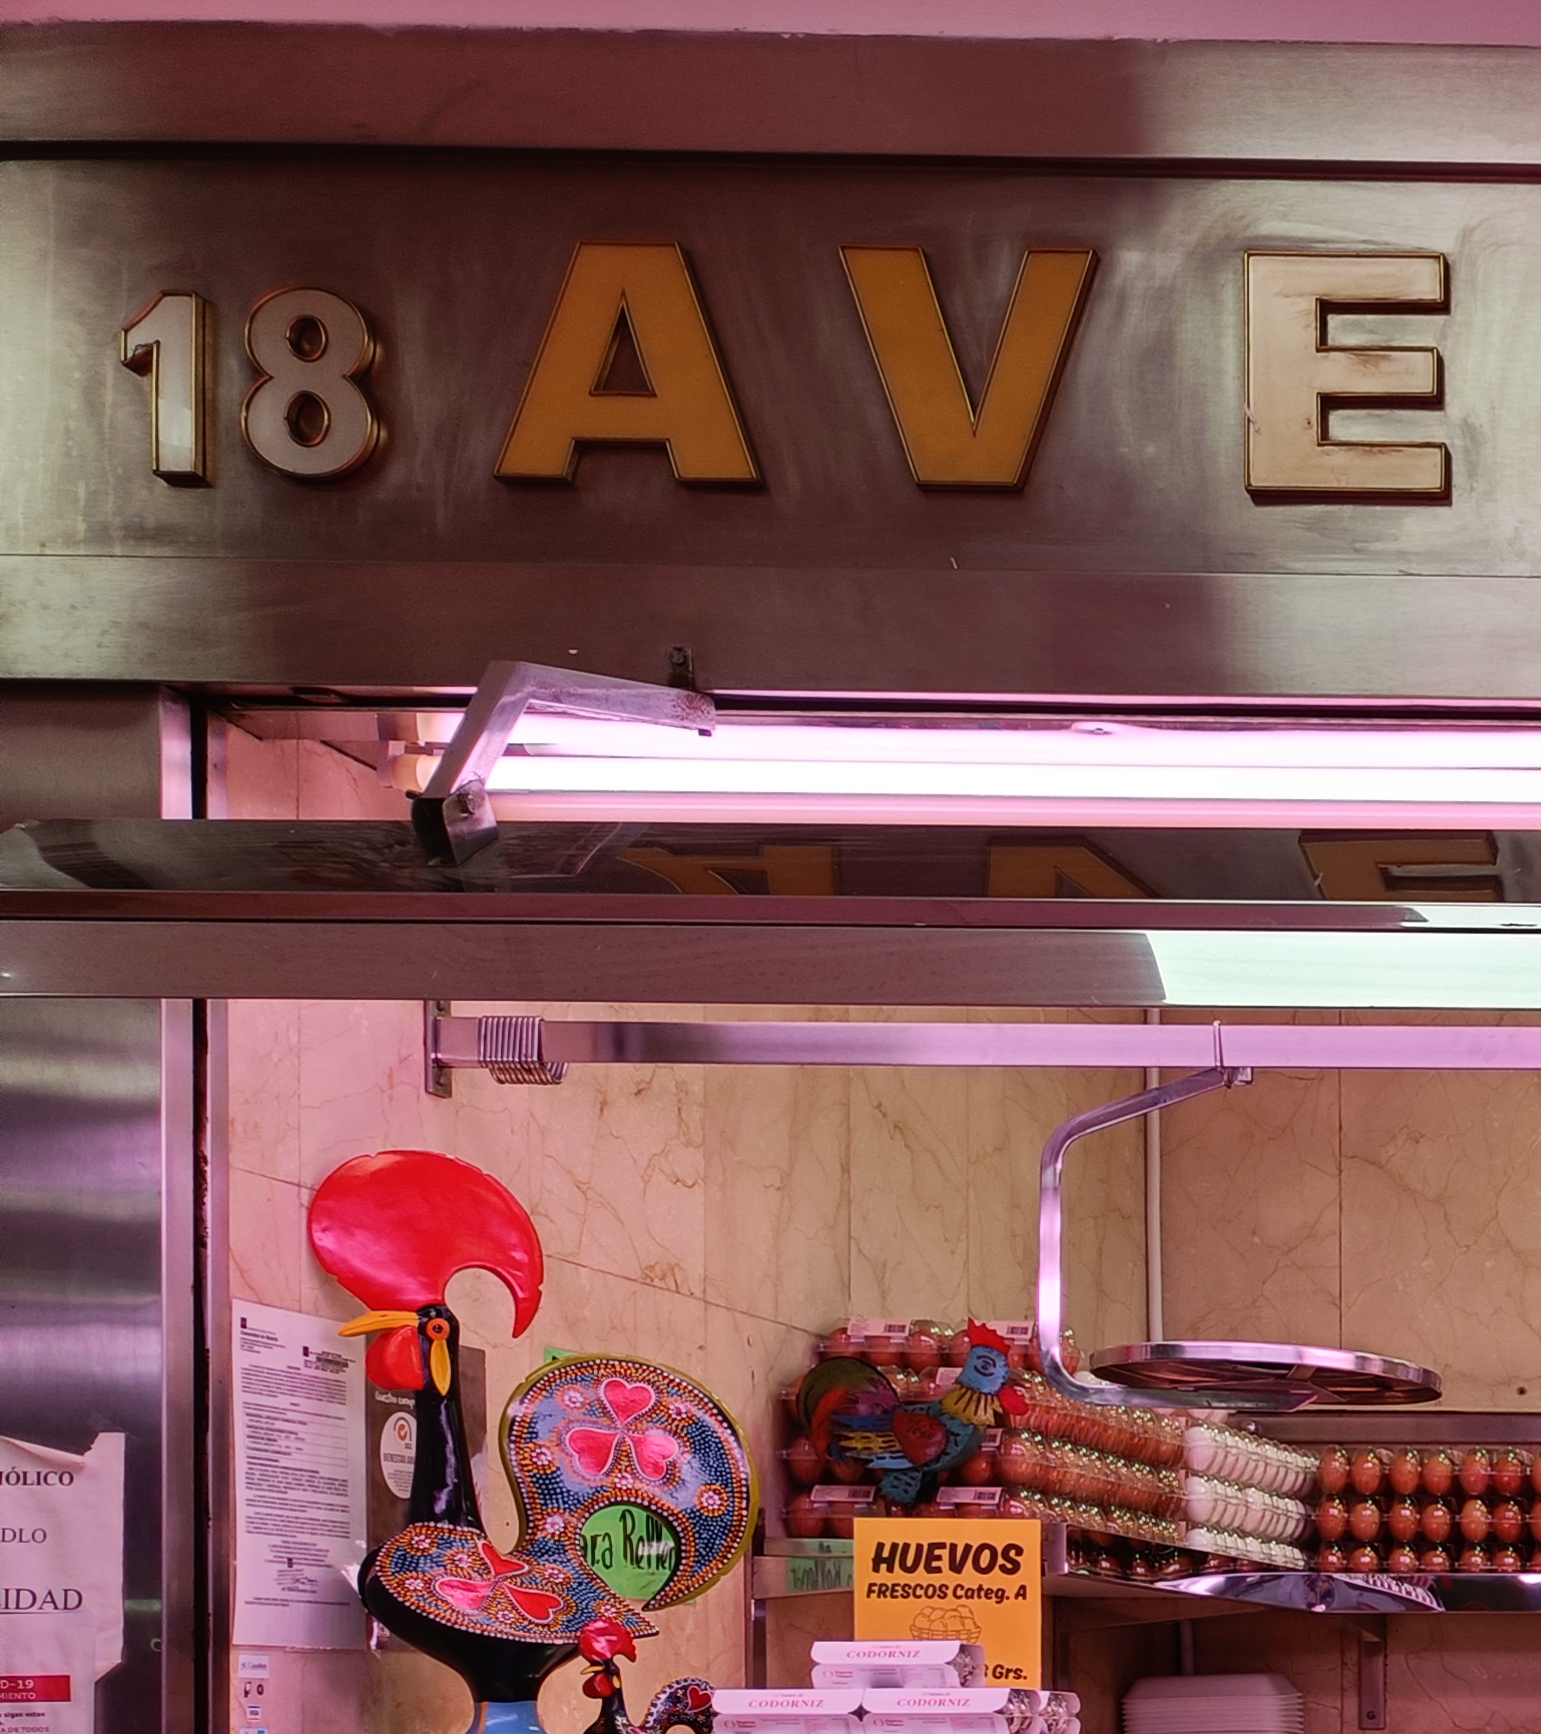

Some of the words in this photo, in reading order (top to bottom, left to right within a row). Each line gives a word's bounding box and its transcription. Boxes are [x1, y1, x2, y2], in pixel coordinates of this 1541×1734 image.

[119, 286, 384, 486] 18
[0, 1466, 74, 1486] ÓLICO
[871, 1541, 1025, 1576] HUEVOS
[0, 1588, 83, 1611] IDAD
[866, 1582, 950, 1600] FRESCOS
[952, 1583, 1011, 1604] Categ.
[1014, 1584, 1028, 1601] A
[846, 1650, 921, 1659] CODORNIZ
[991, 1663, 1028, 1680] Grs.
[748, 1699, 824, 1708] CODORNIZ
[896, 1698, 970, 1707] CODORNIZ
